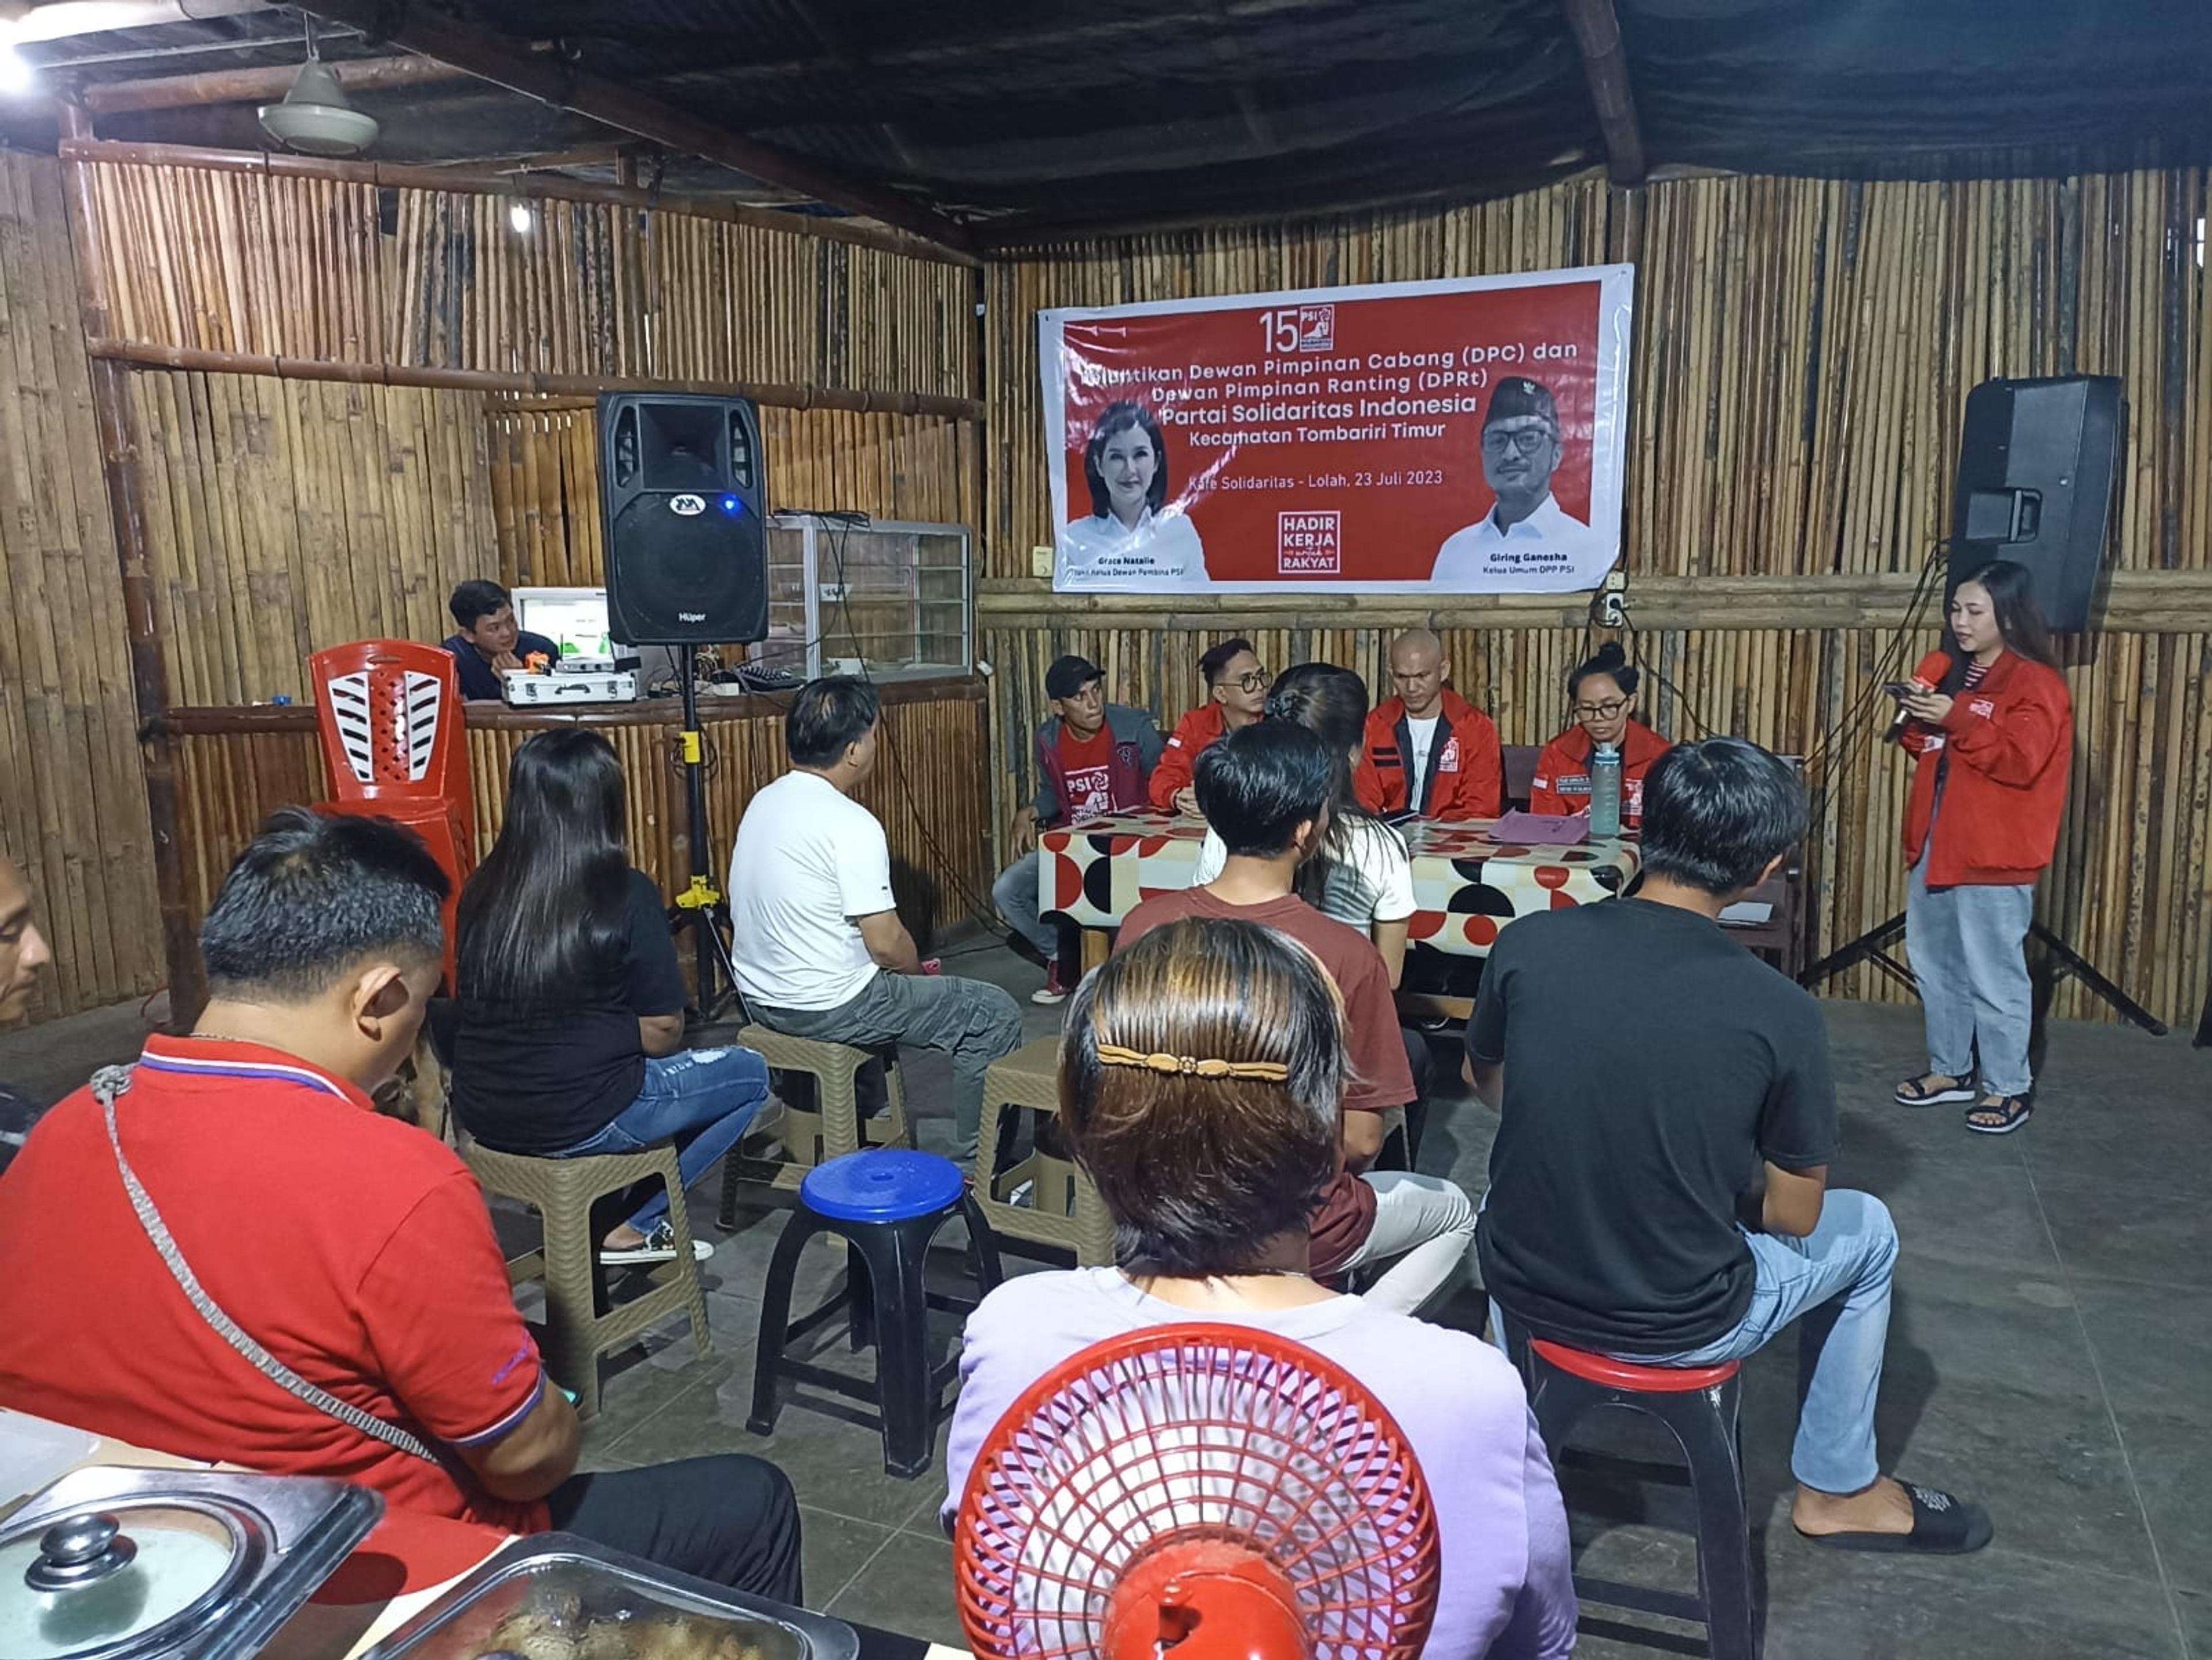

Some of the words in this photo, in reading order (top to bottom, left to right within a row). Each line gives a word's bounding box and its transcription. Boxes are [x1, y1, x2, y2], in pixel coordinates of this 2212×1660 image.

[1259, 310, 1299, 354] 15
[1081, 366, 1183, 386] lantikan
[1190, 364, 1256, 380] Dewan
[1264, 356, 1360, 377] Pimpinan
[1368, 351, 1455, 369] Cabang
[1463, 343, 1525, 367] (DPC)
[1532, 342, 1578, 359] dan
[1152, 387, 1218, 402] Dewan
[1226, 380, 1320, 400] Pimpinan
[1328, 374, 1410, 394] Ranting
[1418, 368, 1488, 392] (DPRt)
[1161, 404, 1227, 426] Partai
[1232, 400, 1354, 423] Solidaritas
[1359, 393, 1476, 417] Indonesia
[1190, 431, 1292, 446] Kecamatan
[1296, 423, 1386, 442] Tombariri
[1391, 422, 1446, 438] Timur
[1222, 475, 1294, 490] Solidaritas
[1308, 473, 1351, 488] Lolah,
[1354, 472, 1373, 486] 23
[1376, 471, 1402, 486] Juli
[1406, 470, 1443, 485] 2023
[1283, 517, 1335, 531] HADIR
[1283, 532, 1335, 547] KERJA
[1098, 556, 1122, 565] Grace
[1123, 556, 1156, 565] Natalie
[1283, 557, 1335, 569] RAKYAT
[1490, 553, 1521, 564] Giring
[1522, 552, 1568, 562] Ganesha
[1066, 776, 1092, 793] PSI
